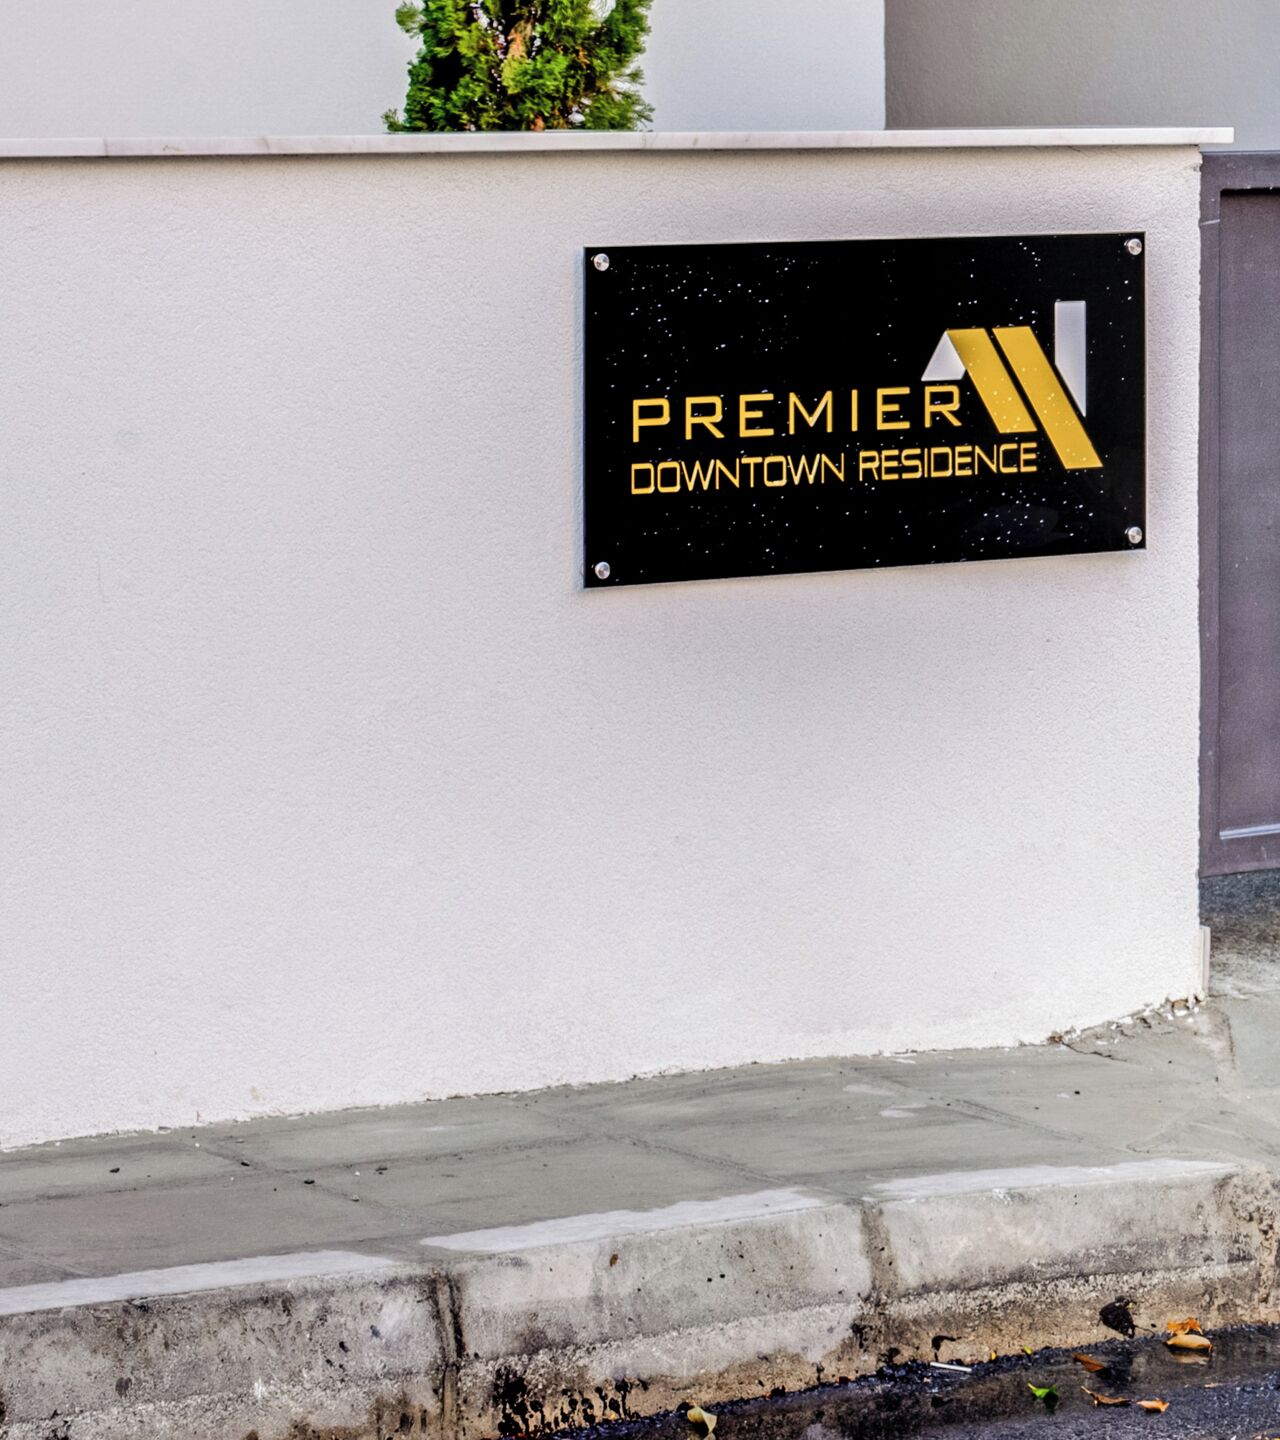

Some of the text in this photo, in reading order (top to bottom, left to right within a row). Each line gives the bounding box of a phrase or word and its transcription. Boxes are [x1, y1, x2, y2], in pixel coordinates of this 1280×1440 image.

[633, 385, 961, 442] PREMIER
[632, 442, 1038, 494] DOWNTOWN RESIDENCE
